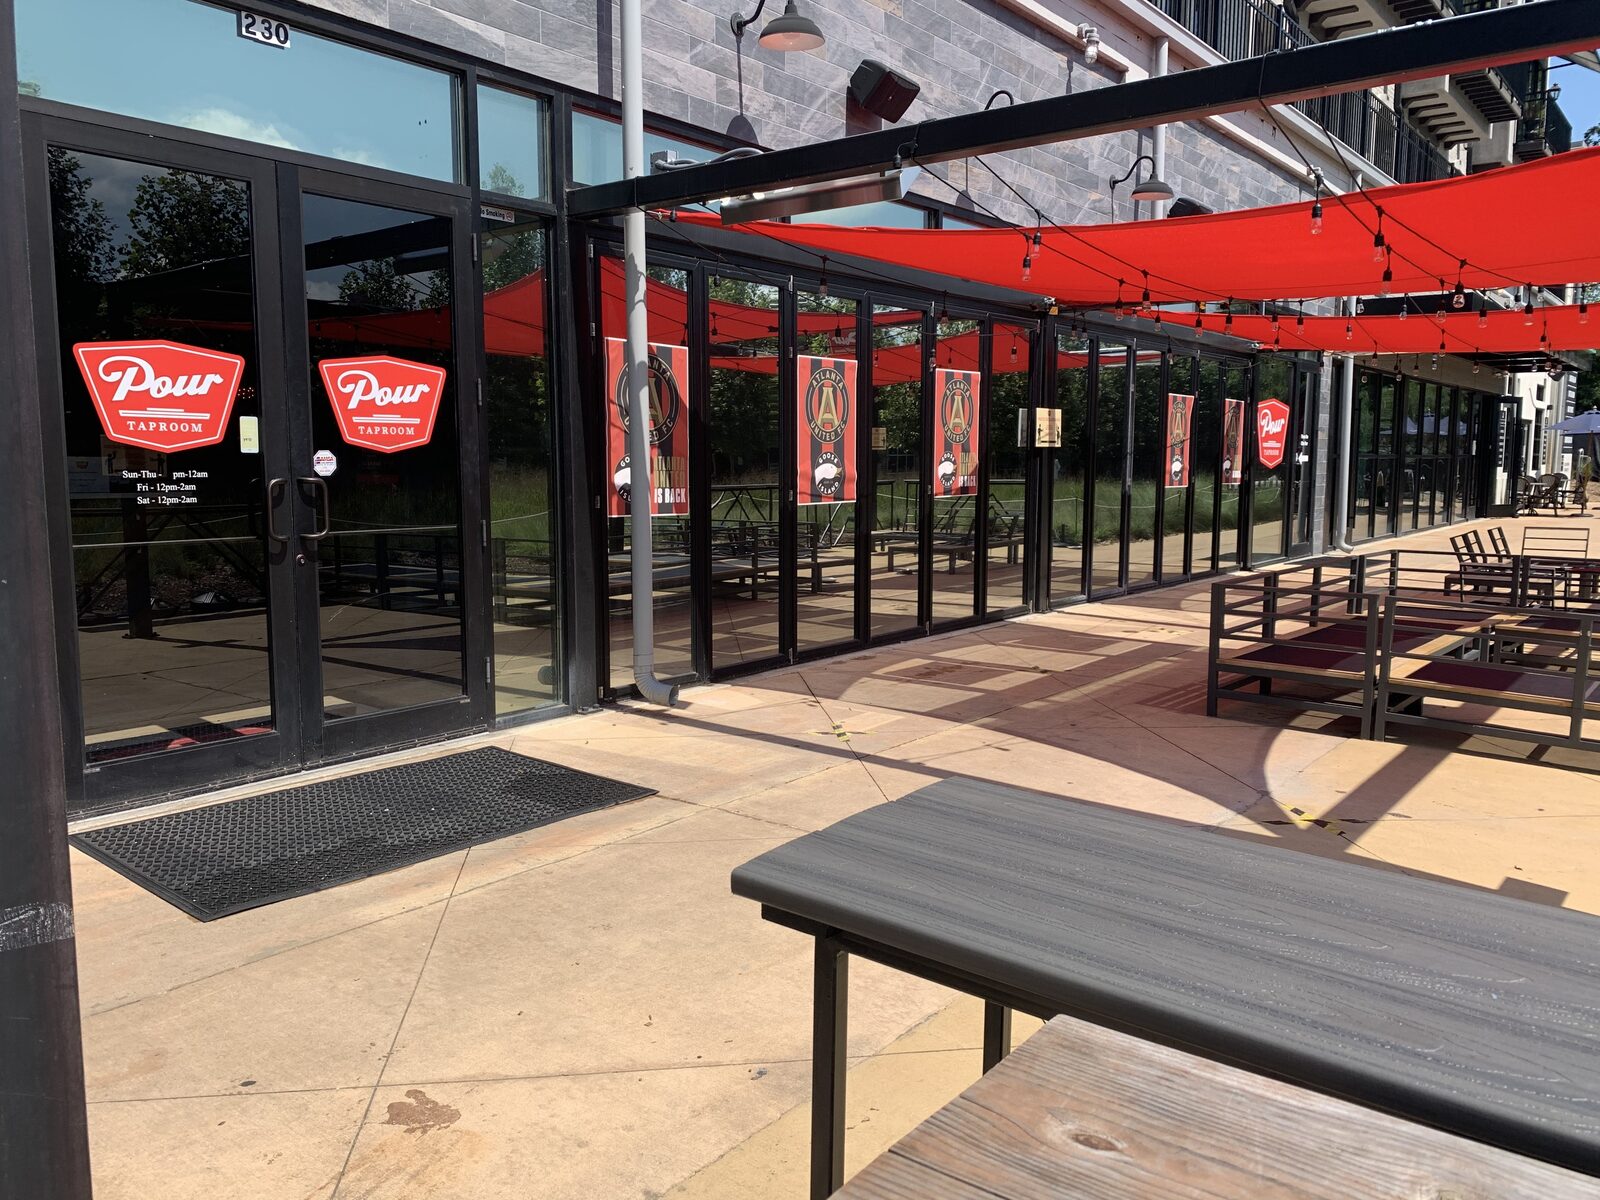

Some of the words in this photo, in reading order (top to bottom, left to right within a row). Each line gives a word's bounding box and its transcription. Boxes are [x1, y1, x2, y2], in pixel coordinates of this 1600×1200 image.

[245, 13, 289, 45] 230
[486, 208, 505, 220] Smoking
[98, 355, 224, 401] Pour
[812, 370, 843, 390] ATLANTA
[337, 369, 431, 409] Pour
[946, 381, 970, 398] ATLANTA
[127, 421, 203, 433] TAPROOM
[358, 426, 415, 435] TAPROOM
[811, 420, 836, 441] UNITED
[837, 421, 846, 434] FC
[1260, 409, 1285, 437] Pour
[653, 455, 685, 471] ATLANTA
[819, 452, 838, 464] GOOSE
[122, 470, 157, 479] Sun-Thu
[172, 470, 209, 480] pm-12am
[136, 482, 149, 491] Fri
[156, 482, 197, 493] 12pm-2am
[654, 487, 663, 503] IS
[664, 487, 686, 503] BACK
[818, 481, 839, 494] ISLAND
[137, 496, 150, 505] Sat
[157, 495, 198, 506] 12pm-2am
